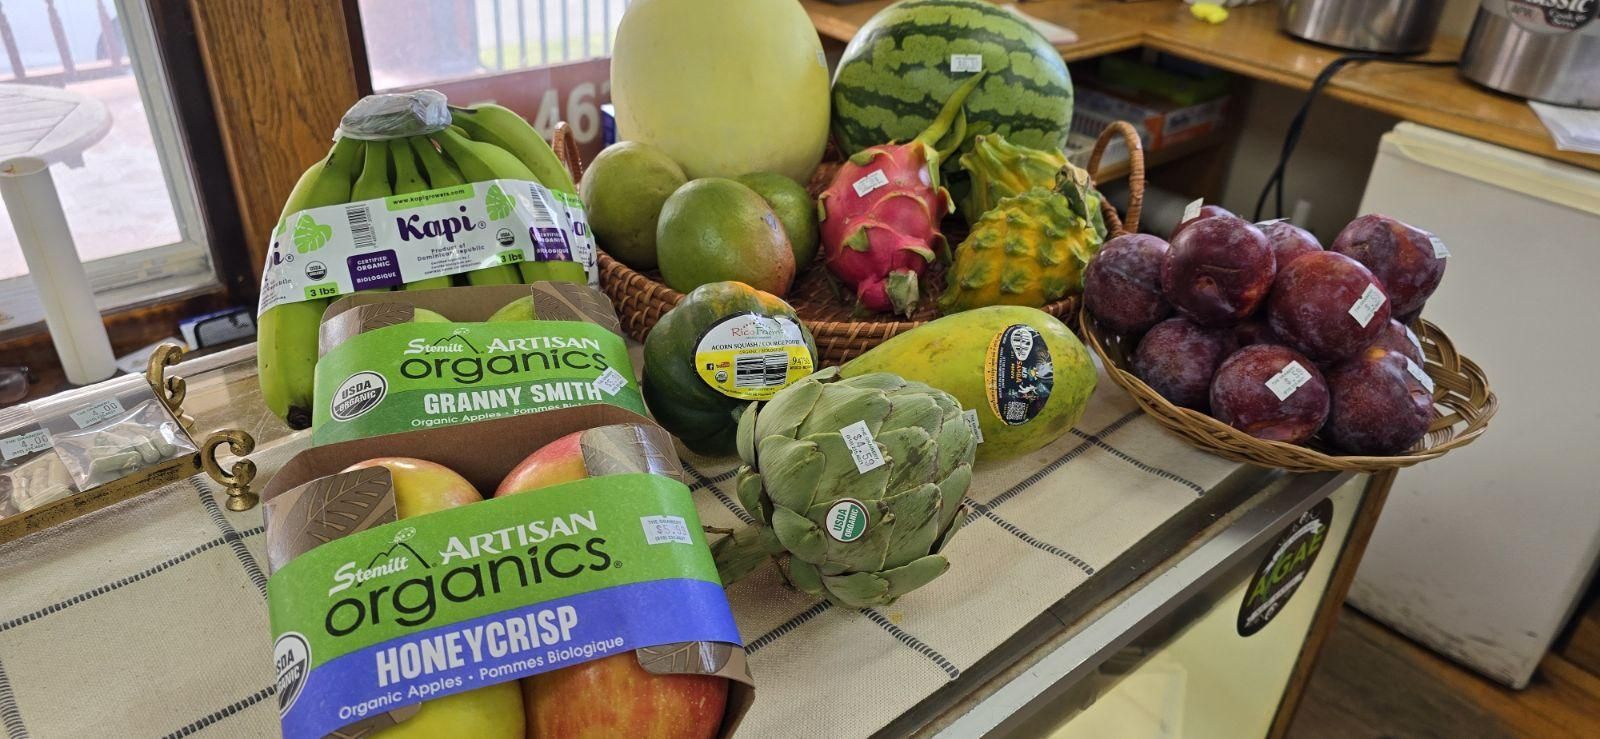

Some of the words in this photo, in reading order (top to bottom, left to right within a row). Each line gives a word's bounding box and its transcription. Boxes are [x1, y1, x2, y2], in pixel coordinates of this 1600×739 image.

[534, 82, 611, 144] 46
[396, 205, 476, 242] Kapi
[356, 261, 391, 271] ORGANIC
[357, 256, 387, 265] CERTIFIED
[500, 255, 506, 263] 3
[508, 253, 523, 261] lbs
[356, 272, 396, 283] BIOLOGIQUE
[310, 289, 316, 297] 3
[319, 286, 336, 296] lbs
[404, 338, 463, 355] Stemilt
[487, 336, 600, 354] ARTISAN
[733, 341, 758, 350] SQUASH
[400, 349, 608, 384] organics
[339, 390, 376, 412] ORGANIC
[341, 379, 371, 399] USDA
[424, 387, 521, 415] GRANNY
[530, 382, 602, 403] SMITH
[411, 416, 459, 427] Organic
[461, 410, 501, 422] Apples
[513, 404, 560, 415] Pommes
[853, 433, 875, 467] $4.59
[833, 508, 848, 532] USDA
[844, 508, 859, 537] ORGANIC
[439, 510, 597, 565] ARTISAN
[325, 537, 611, 637] organics
[328, 556, 409, 597] Stemilt
[376, 605, 578, 688] HONEYCRISP
[276, 648, 295, 675] SDA
[338, 690, 402, 720] Organic
[407, 676, 462, 699] Apples
[479, 656, 543, 680] Pommes
[548, 636, 624, 664] Biologique
